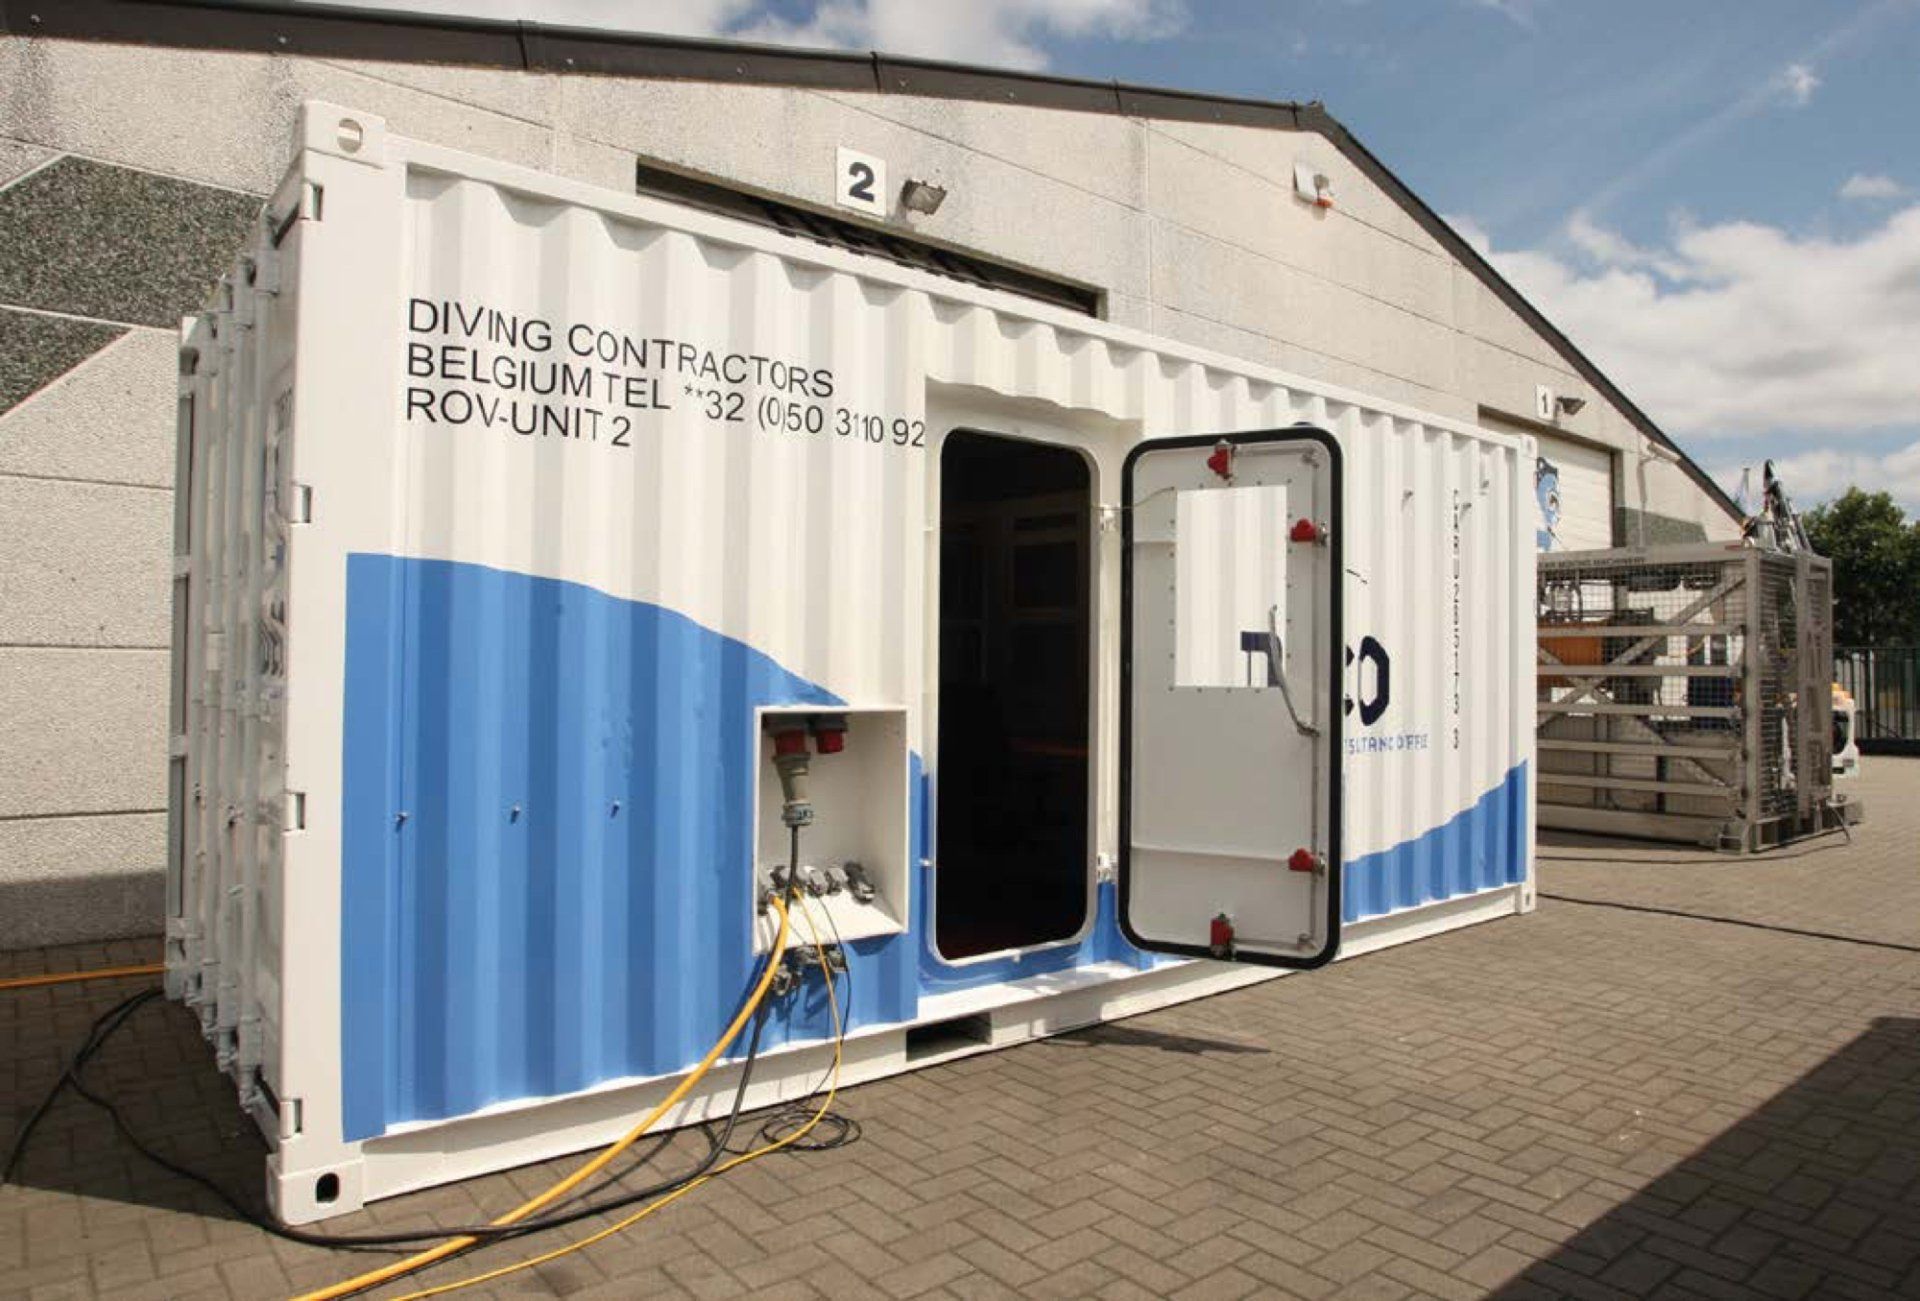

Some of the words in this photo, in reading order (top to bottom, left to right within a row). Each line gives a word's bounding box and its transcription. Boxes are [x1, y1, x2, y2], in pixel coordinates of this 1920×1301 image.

[848, 161, 875, 203] 2
[408, 298, 552, 352] DIVING
[567, 323, 834, 398] CONTRACTORS
[406, 386, 603, 440] ROV-UNIT
[611, 415, 632, 448] 2
[408, 342, 592, 398] BELGIUM
[602, 371, 672, 409] TEL
[758, 395, 824, 435] (0)50
[836, 408, 884, 443] 3110
[892, 418, 926, 448] 92
[1541, 391, 1549, 414] 1
